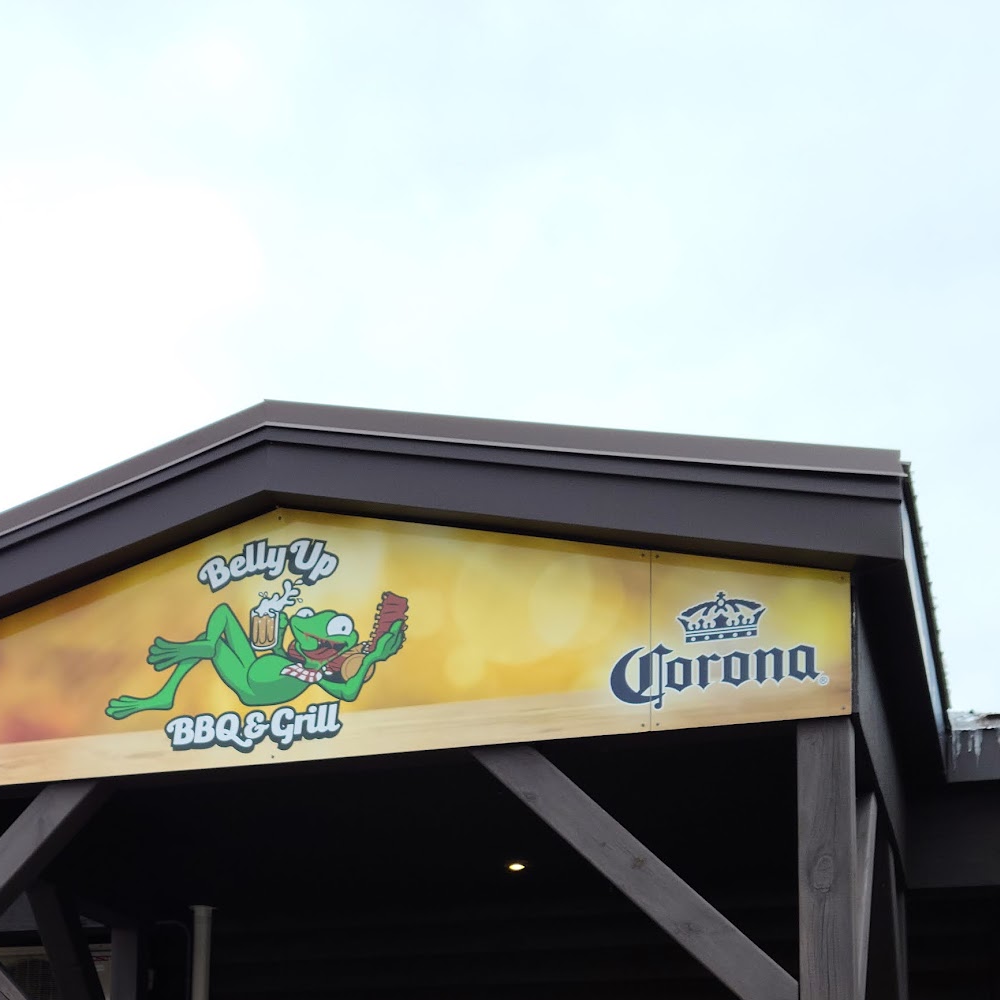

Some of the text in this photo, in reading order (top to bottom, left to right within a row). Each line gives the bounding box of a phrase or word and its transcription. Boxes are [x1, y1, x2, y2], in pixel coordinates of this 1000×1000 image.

[198, 538, 339, 593] Belly Up
[610, 643, 821, 710] Corona
[165, 701, 342, 753] BBQ & Grill
